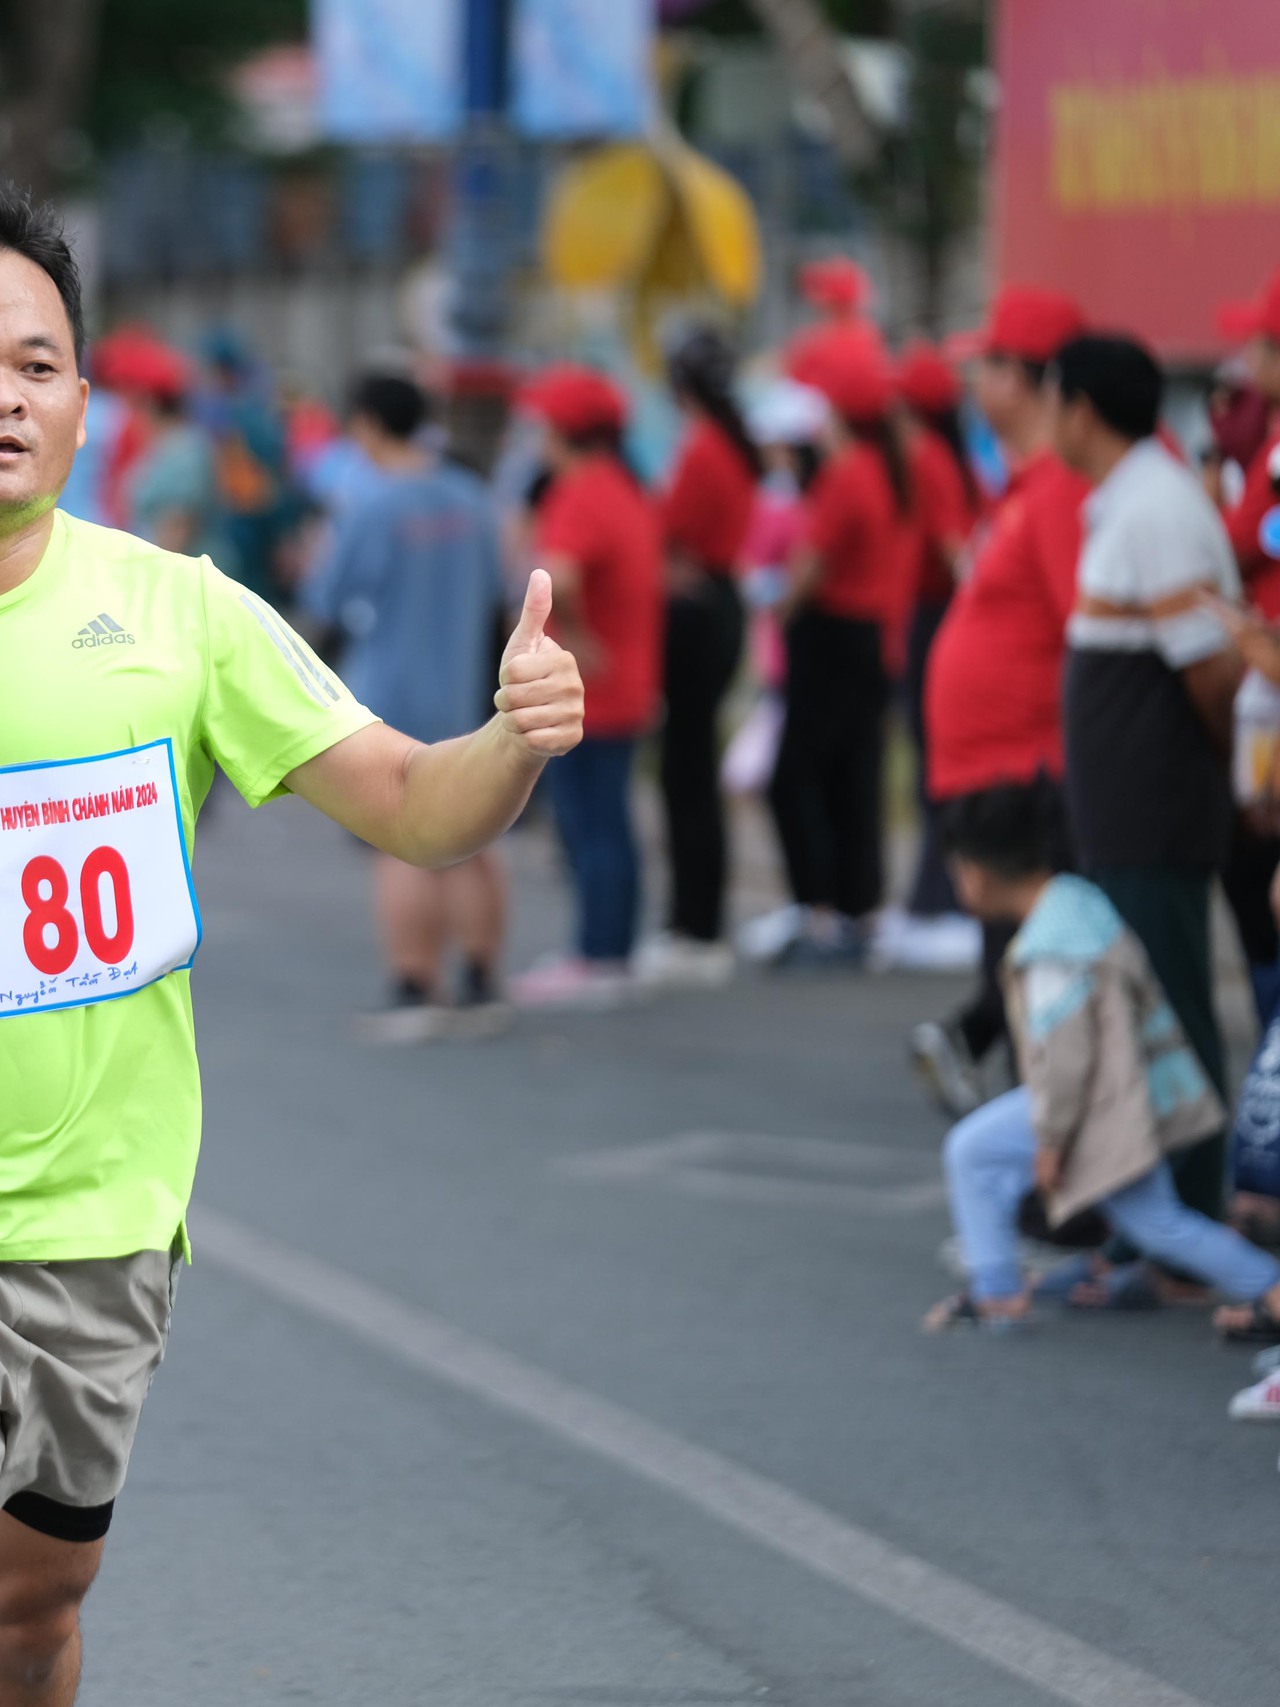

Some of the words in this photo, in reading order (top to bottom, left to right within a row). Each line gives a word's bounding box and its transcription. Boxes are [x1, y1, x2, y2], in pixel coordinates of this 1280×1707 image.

[71, 632, 136, 649] adidas
[0, 800, 41, 832] HUYỆN
[41, 797, 71, 825] BÌNH
[72, 792, 110, 821] CHÁNH
[111, 785, 135, 814] NĂM
[136, 781, 158, 808] 2024
[21, 845, 134, 975] 80
[107, 961, 138, 981] Đạt
